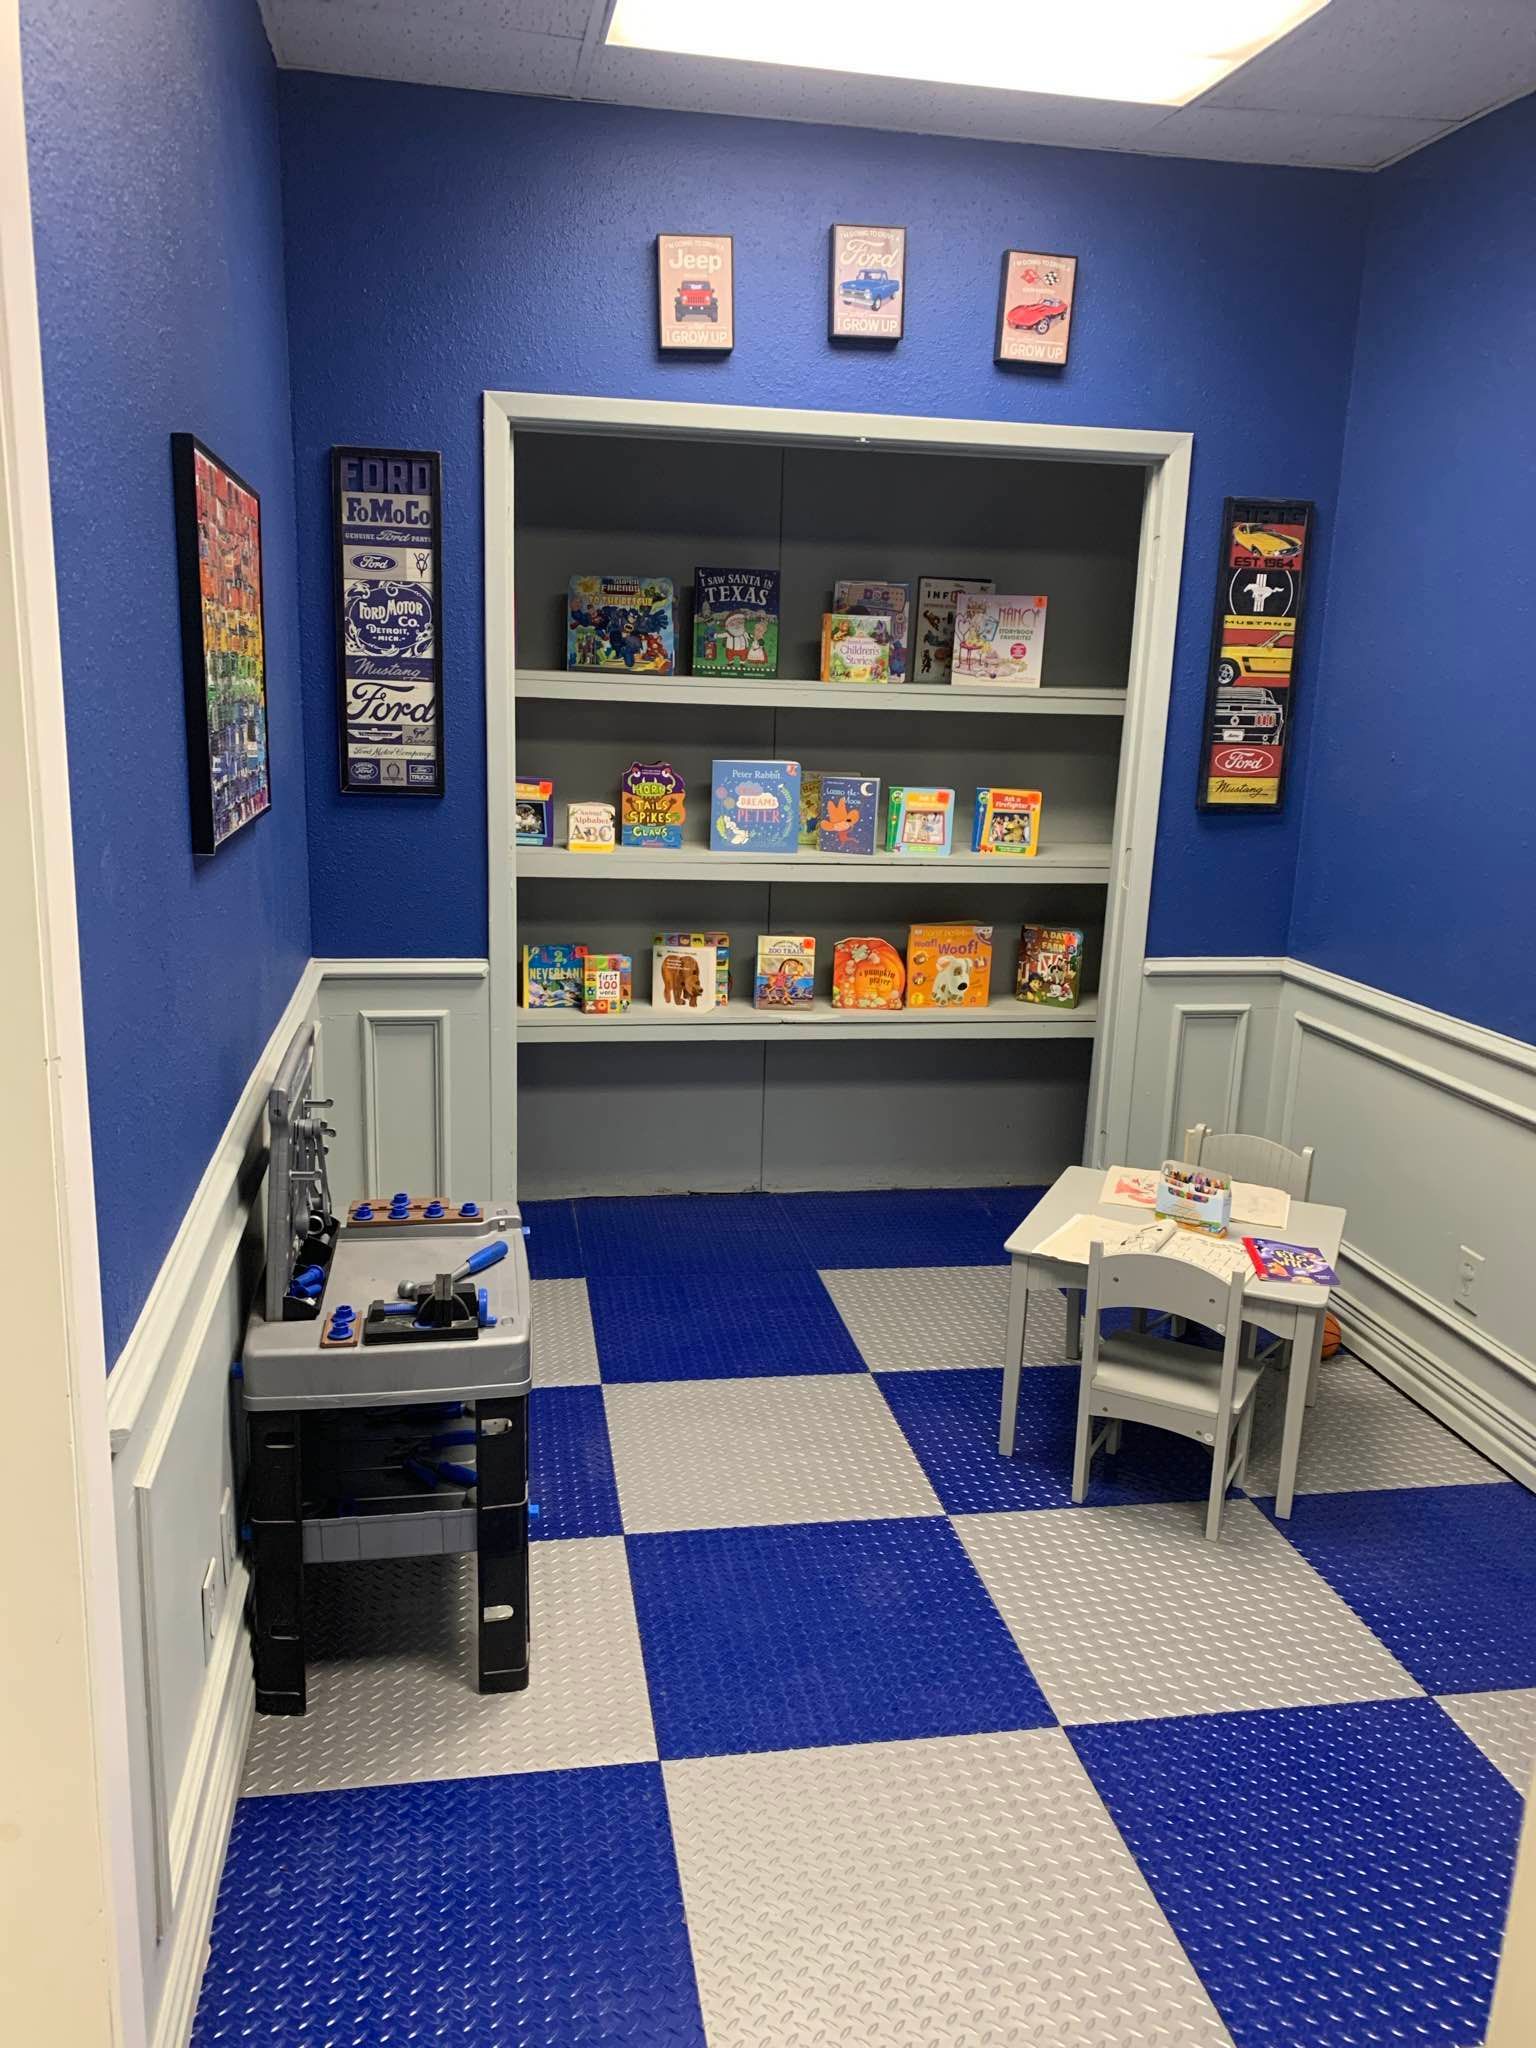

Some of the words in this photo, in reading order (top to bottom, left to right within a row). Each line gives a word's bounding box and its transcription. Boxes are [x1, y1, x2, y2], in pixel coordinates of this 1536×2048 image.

[669, 248, 722, 274] Jeep
[841, 239, 899, 268] Ford
[843, 318, 880, 331] GROW
[882, 319, 898, 332] UP
[671, 330, 709, 342] GROW
[711, 330, 728, 343] UP
[1011, 343, 1046, 357] GROW
[1047, 347, 1063, 360] UP
[342, 459, 430, 495] FORD
[376, 530, 412, 541] Ford
[360, 555, 389, 569] Ford
[707, 575, 726, 585] SAW
[728, 573, 761, 586] SANTA
[705, 585, 769, 606] TEXAS
[359, 601, 386, 620] FORD
[380, 599, 424, 624] MOTOR
[999, 607, 1041, 627] NANCY
[1225, 619, 1293, 628] MUSTANG
[354, 658, 429, 680] Mustang
[347, 682, 435, 723] Ford
[1225, 751, 1264, 769] Ford
[732, 769, 753, 780] Peter
[754, 770, 781, 780] Rabbit
[1215, 779, 1269, 798] Mustang
[938, 939, 979, 955] Woof!
[598, 972, 618, 981] first
[598, 980, 618, 990] 100
